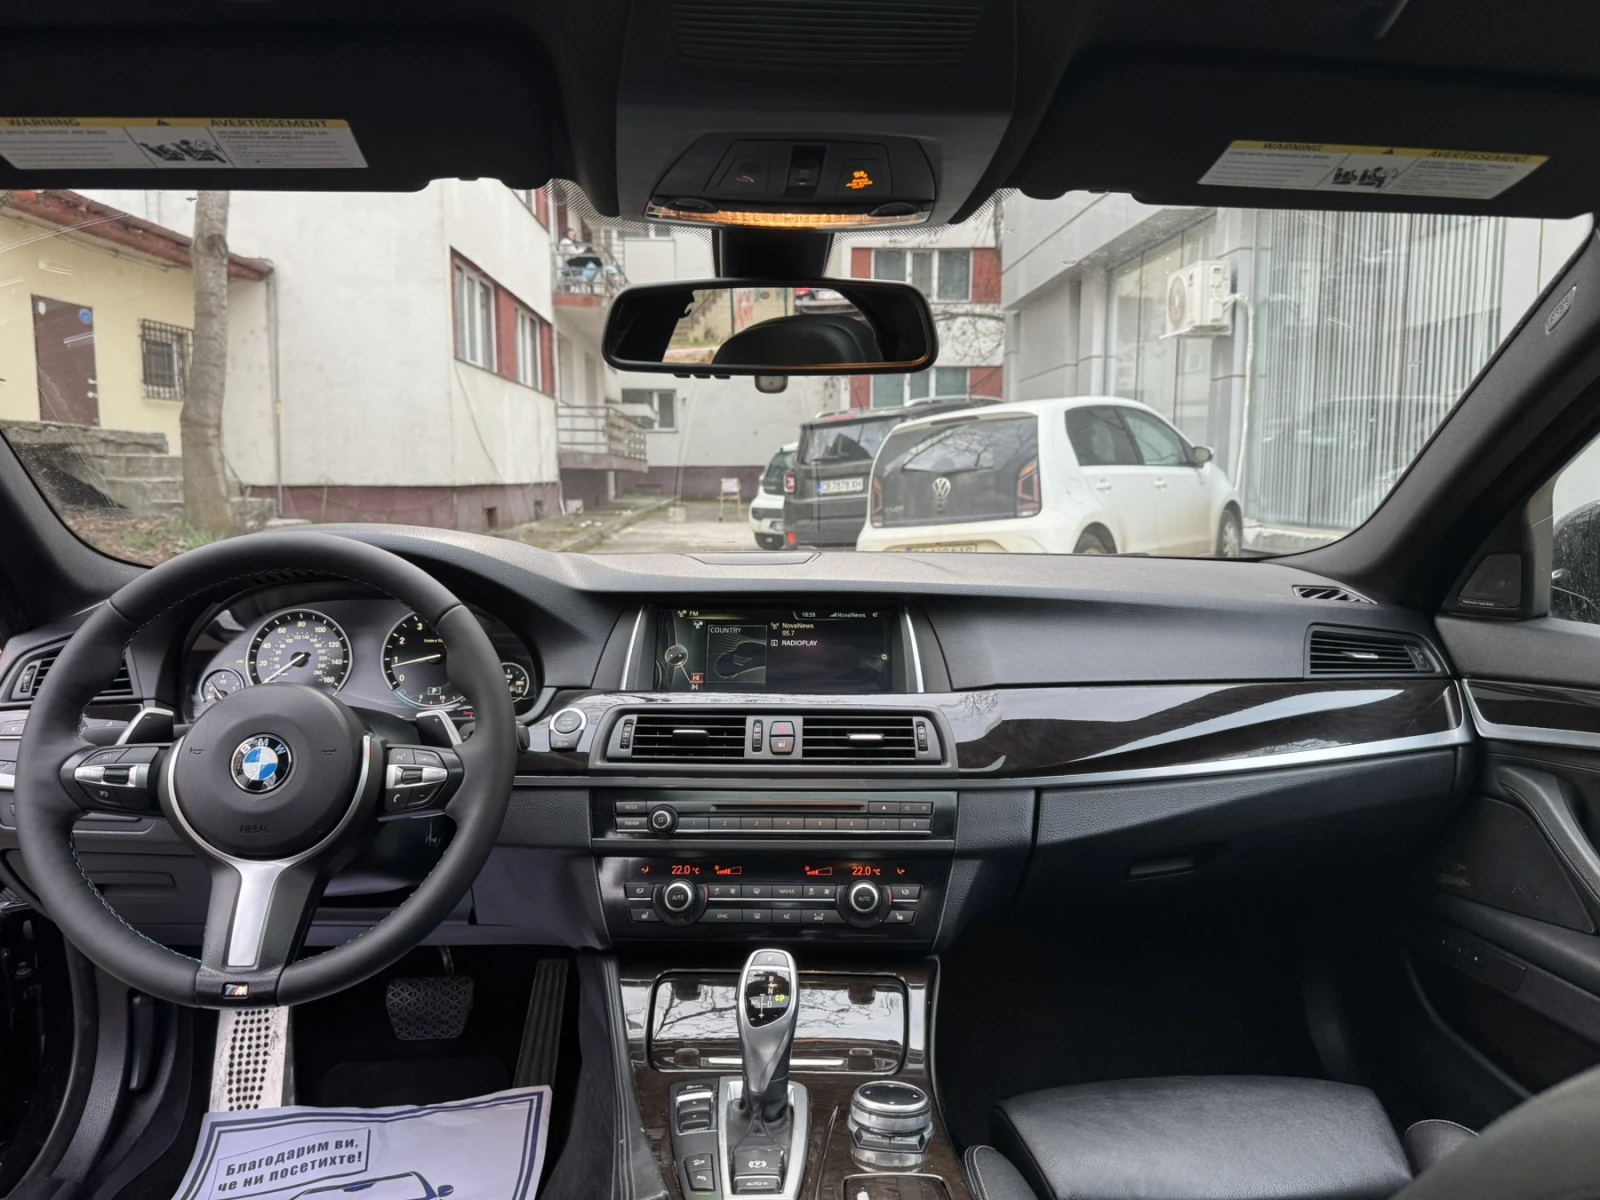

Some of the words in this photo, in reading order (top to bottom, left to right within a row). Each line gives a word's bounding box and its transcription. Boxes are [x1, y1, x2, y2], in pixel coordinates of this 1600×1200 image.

[5, 118, 81, 127] WARNING
[211, 119, 327, 128] AVERTISSEMENT
[1262, 143, 1322, 152] WARNING
[1427, 150, 1530, 163] AVERTISSEMENT
[399, 637, 405, 645] 2
[399, 674, 405, 682] 0
[240, 738, 287, 755] BMW
[239, 824, 271, 834] AIRBAG
[671, 865, 691, 875] 22.0
[852, 866, 871, 875] 22.0
[225, 1141, 329, 1177] Благодарим
[334, 1138, 359, 1150] ви,
[217, 1179, 238, 1192] че
[243, 1174, 264, 1188] ни
[269, 1151, 362, 1182] посетихте!
